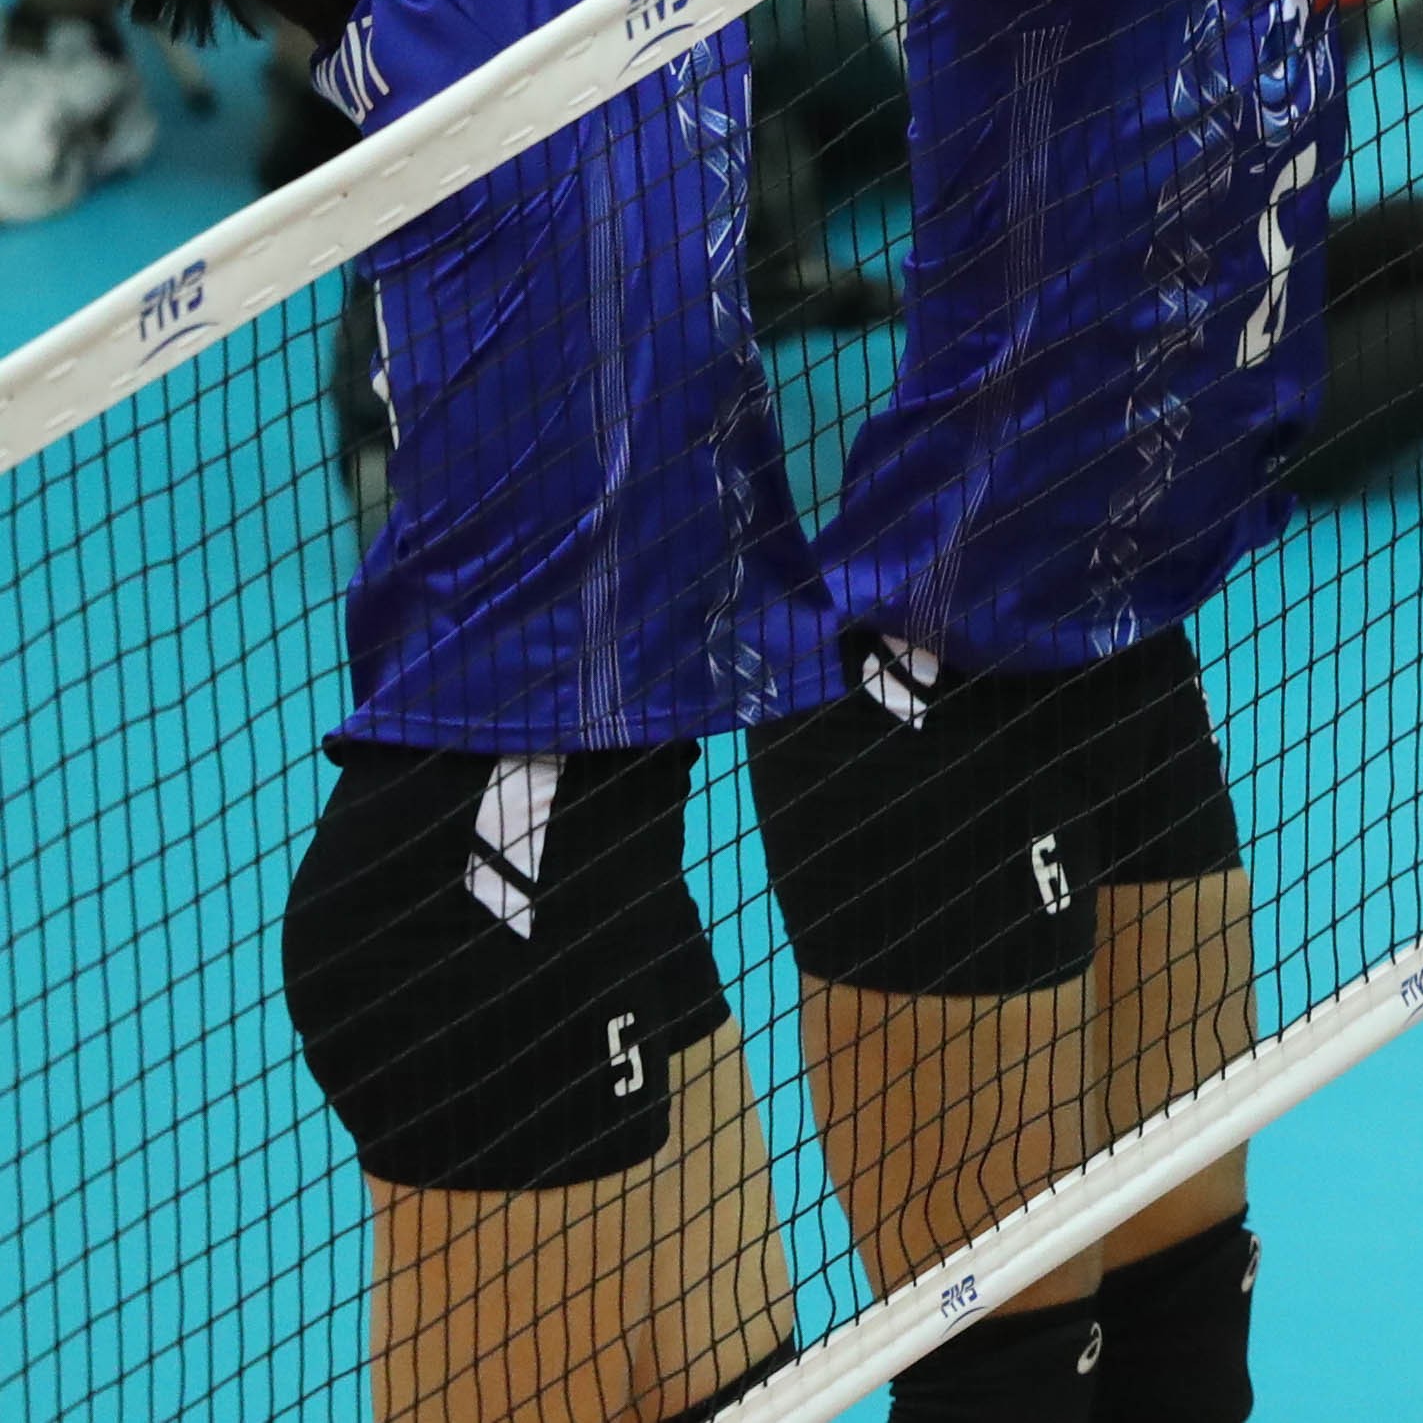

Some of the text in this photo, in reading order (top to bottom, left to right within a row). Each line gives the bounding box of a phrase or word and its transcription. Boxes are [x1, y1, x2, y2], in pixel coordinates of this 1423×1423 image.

[138, 260, 207, 342] FIVB
[1031, 833, 1071, 914] 6
[607, 1012, 644, 1098] 5
[940, 1274, 980, 1319] FIVB
